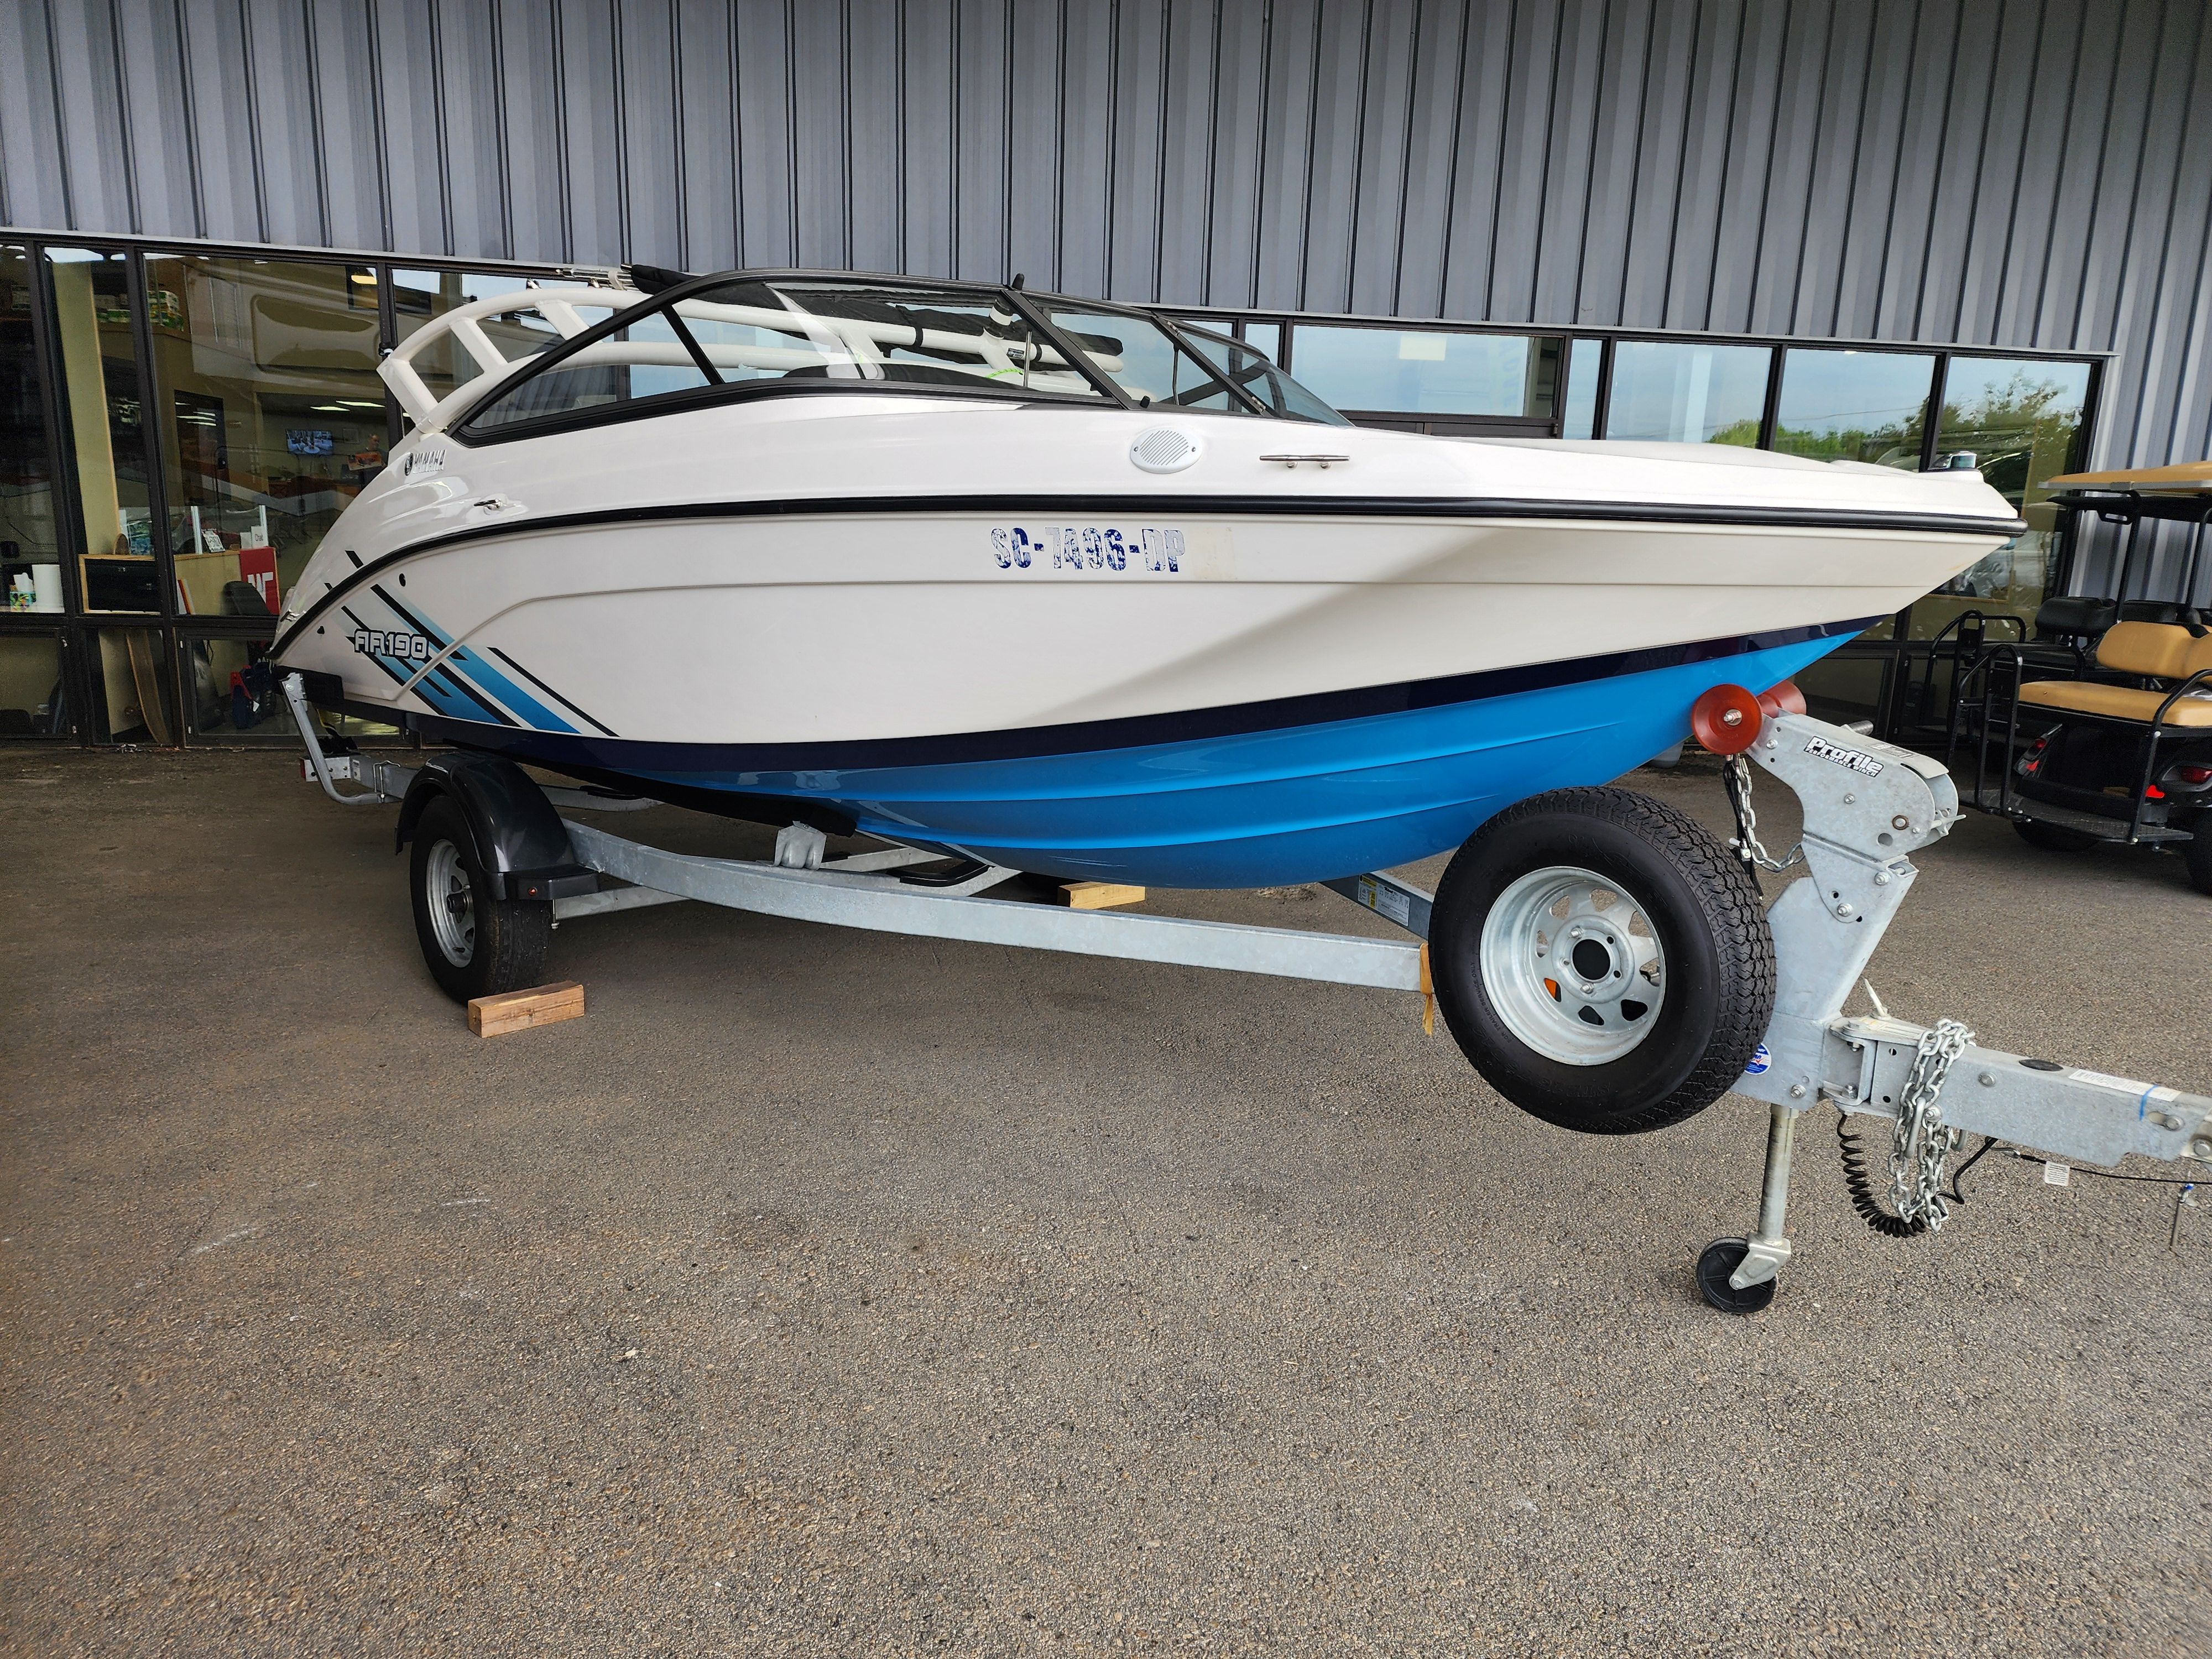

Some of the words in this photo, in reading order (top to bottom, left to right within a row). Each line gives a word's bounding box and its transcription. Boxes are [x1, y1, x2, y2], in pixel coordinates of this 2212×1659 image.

[413, 450, 446, 474] YAMAHA
[354, 629, 427, 659] AR190
[1805, 748, 1851, 769] PERFORMANCE
[1854, 765, 1877, 777] WINCH
[1807, 737, 1883, 773] Profile
[1473, 979, 1486, 1006] SERVICE
[1484, 1008, 1501, 1031] TRAILER
[1502, 1032, 1512, 1044] FOR
